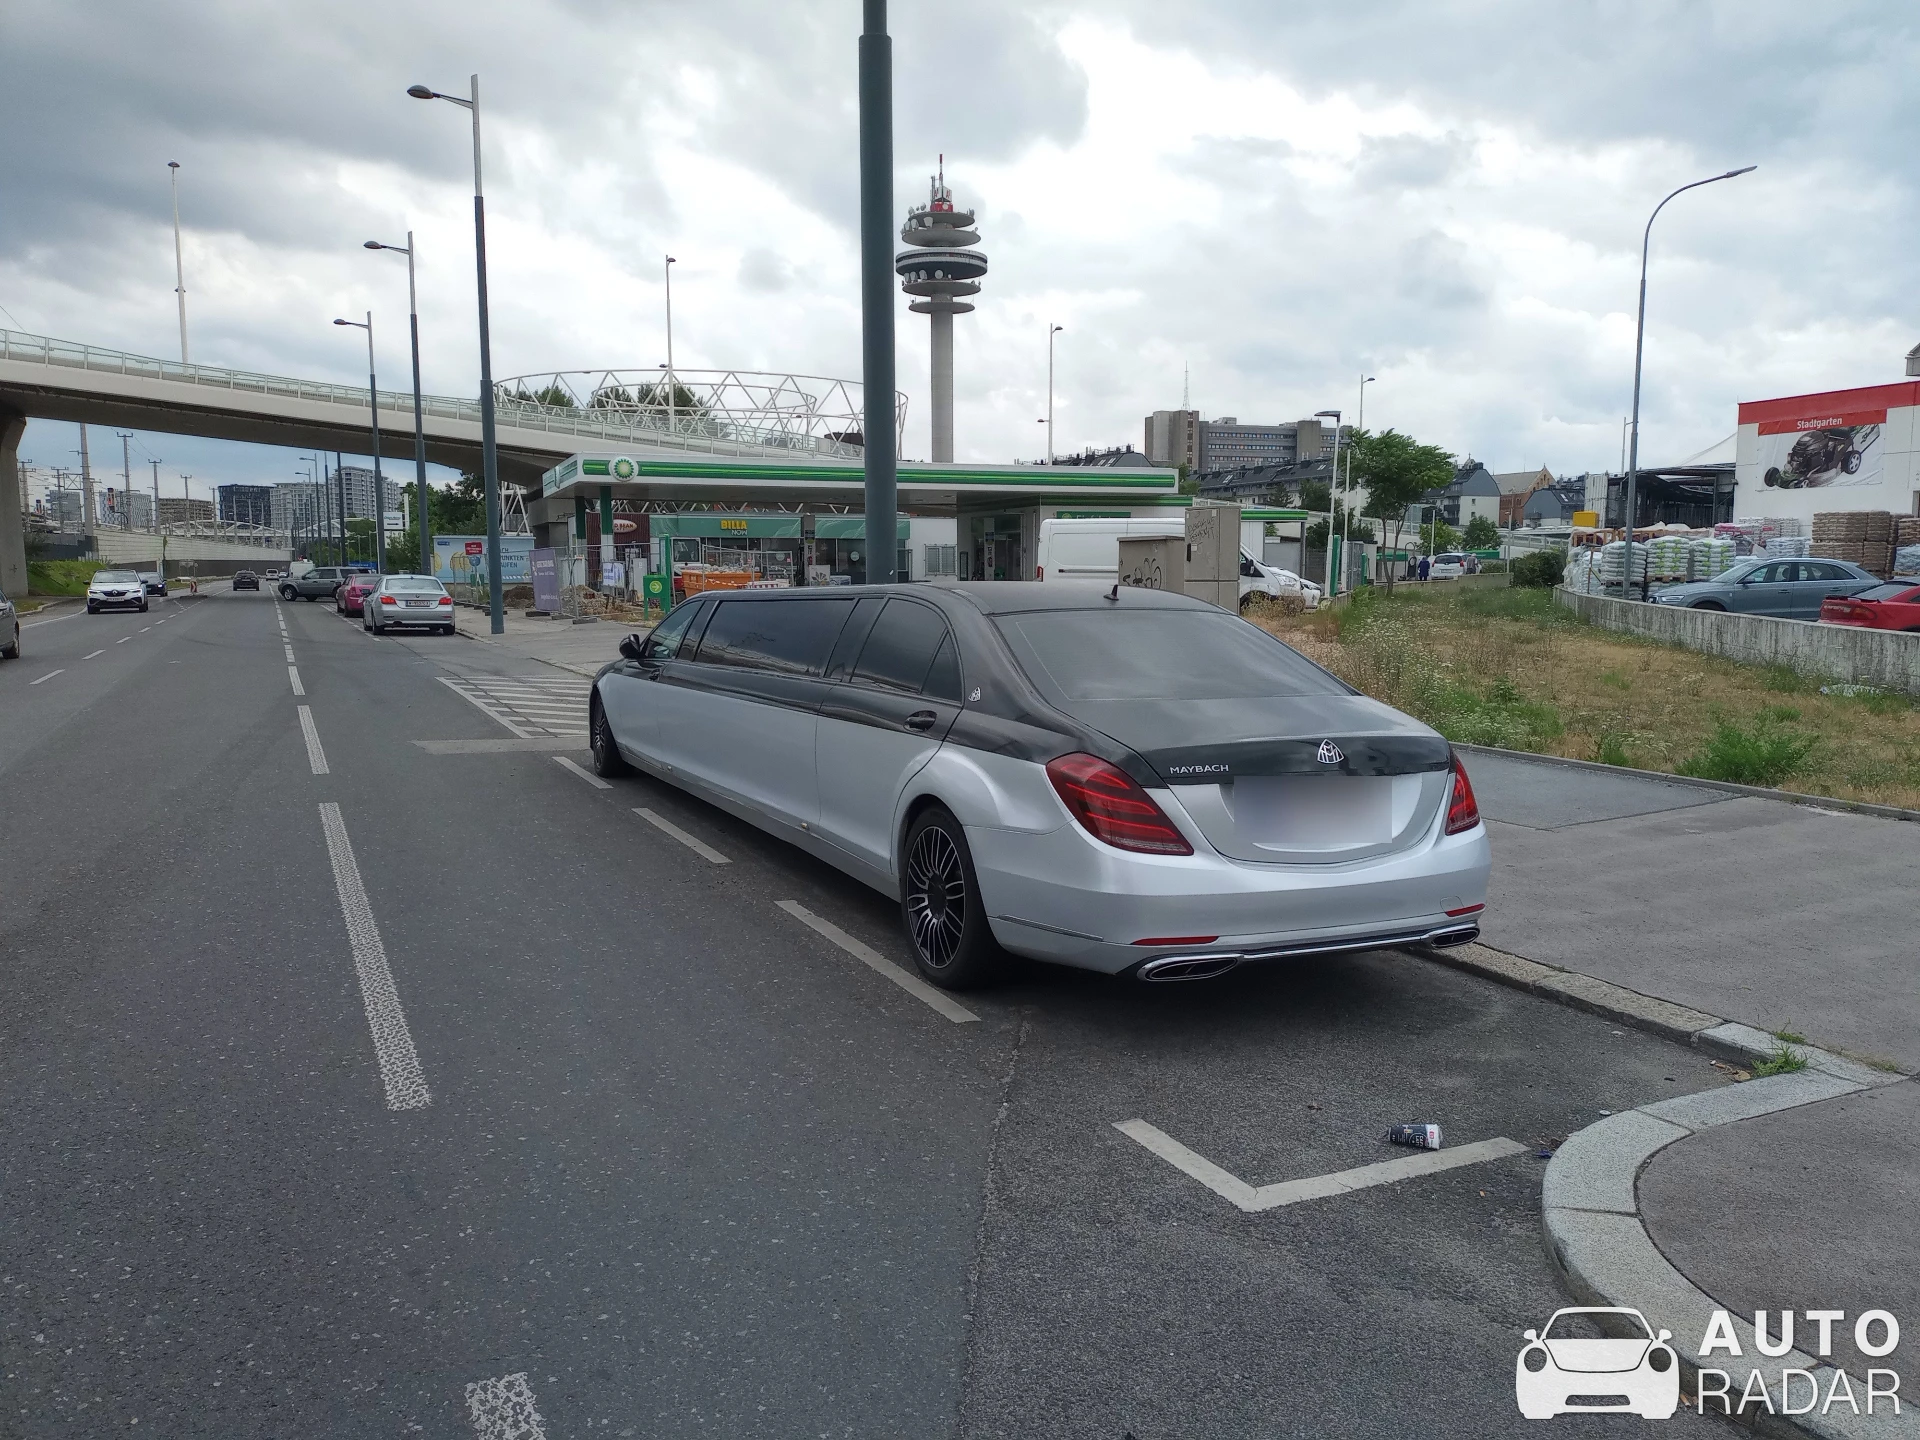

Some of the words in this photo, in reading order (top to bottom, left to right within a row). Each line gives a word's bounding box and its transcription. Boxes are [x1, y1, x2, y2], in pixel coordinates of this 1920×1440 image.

[1797, 417, 1842, 429] Stadtgarten
[721, 519, 748, 530] BILLA
[1170, 764, 1229, 774] MAYBACH
